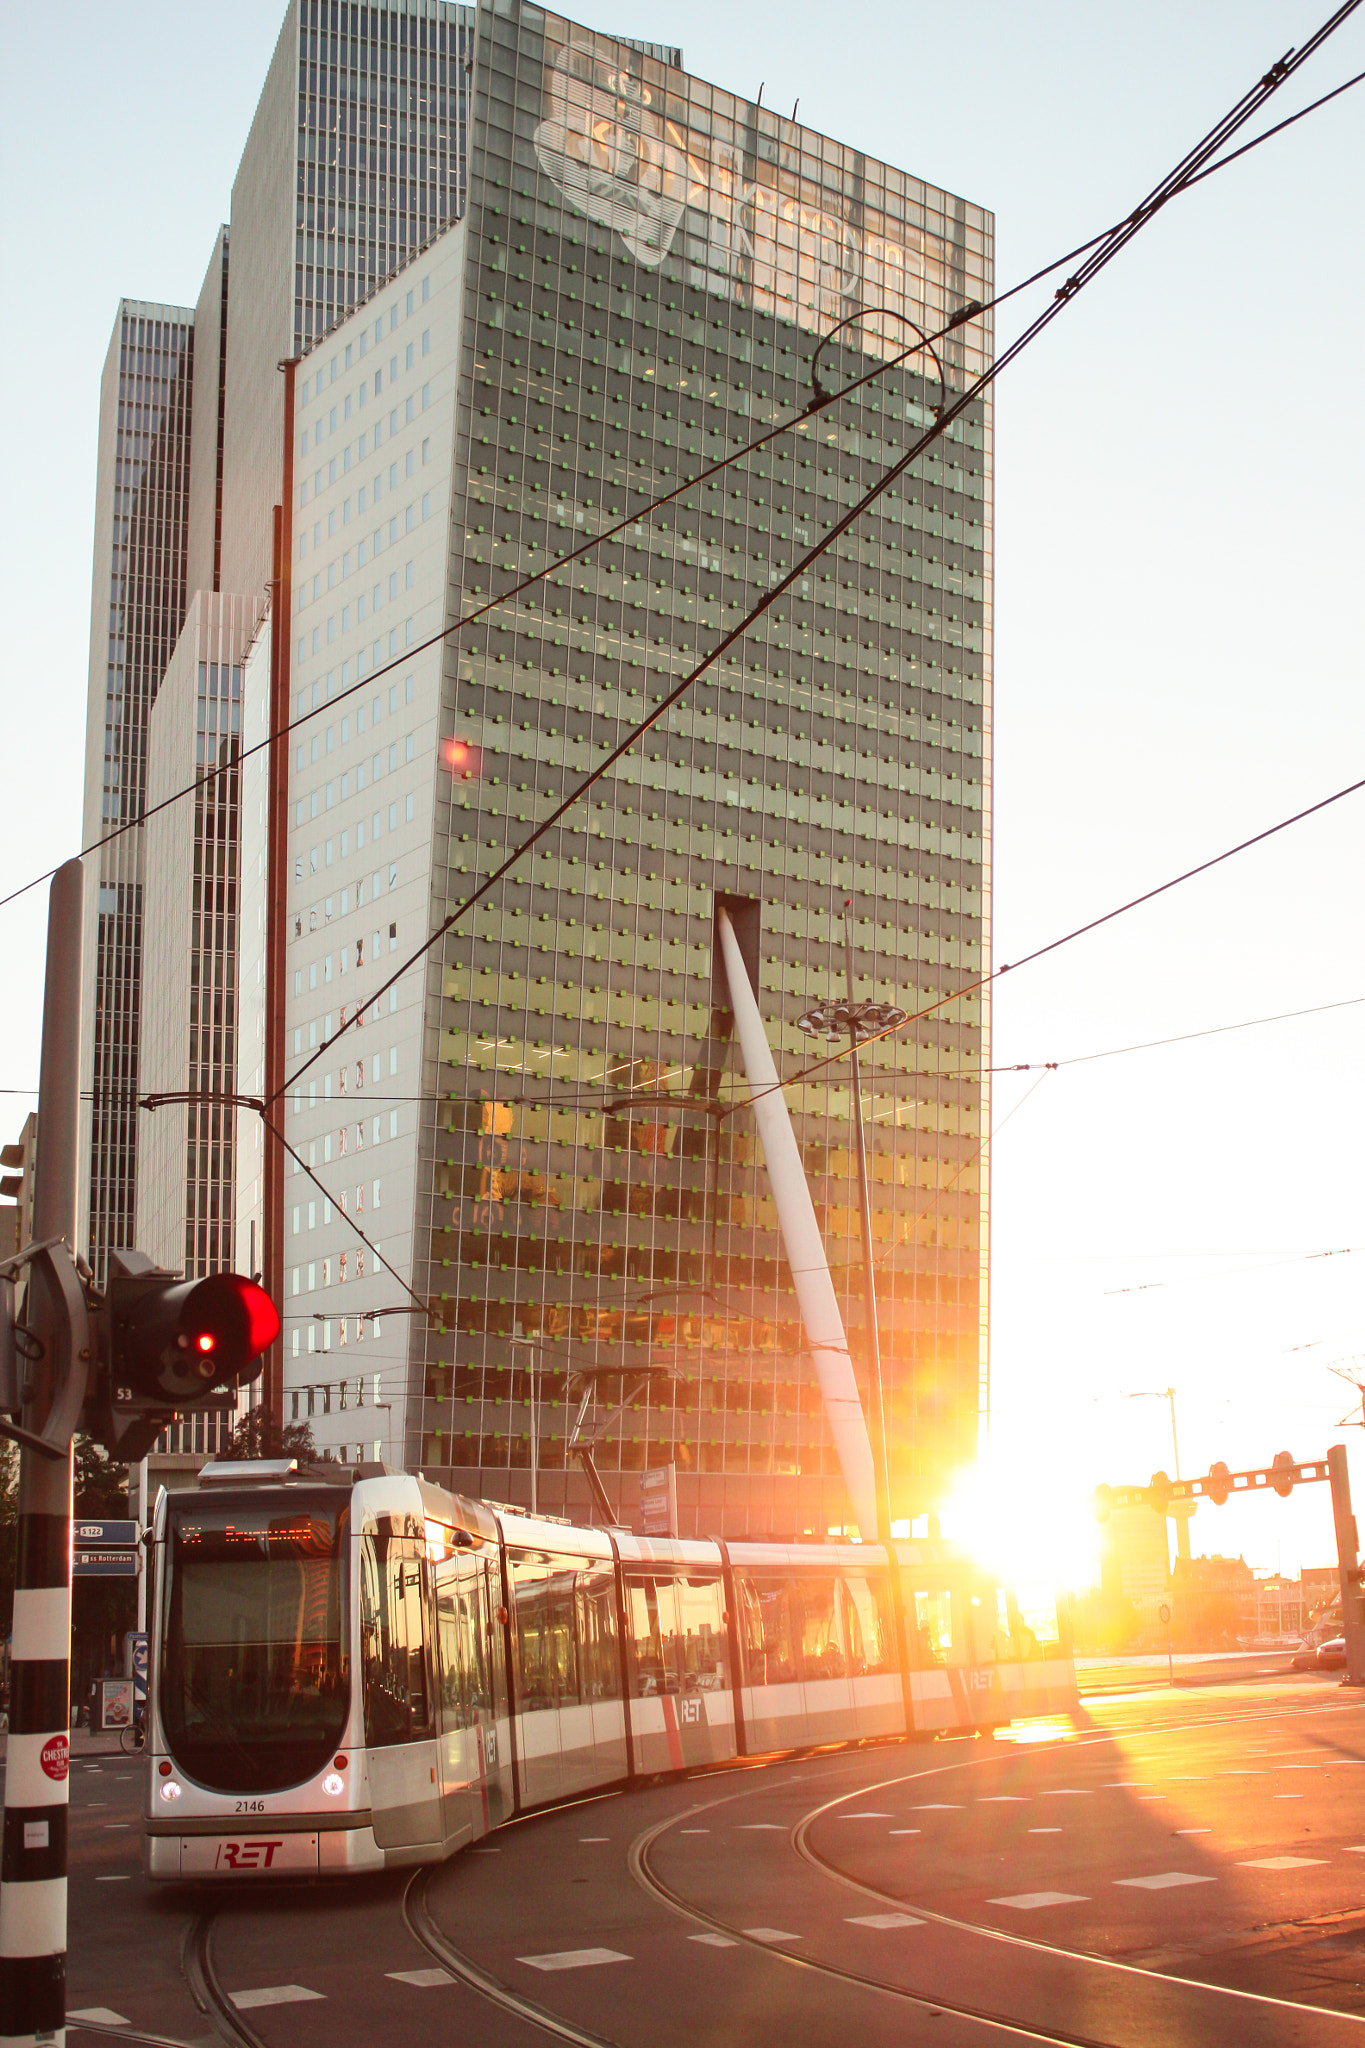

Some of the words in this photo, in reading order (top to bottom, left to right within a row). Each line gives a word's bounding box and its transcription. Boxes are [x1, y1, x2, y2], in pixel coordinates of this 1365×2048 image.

[117, 1388, 132, 1400] 53
[970, 1670, 994, 1690] RET
[681, 1699, 701, 1724] RET
[486, 1730, 496, 1763] RET
[235, 1801, 265, 1812] 2146
[215, 1841, 283, 1870] RET
